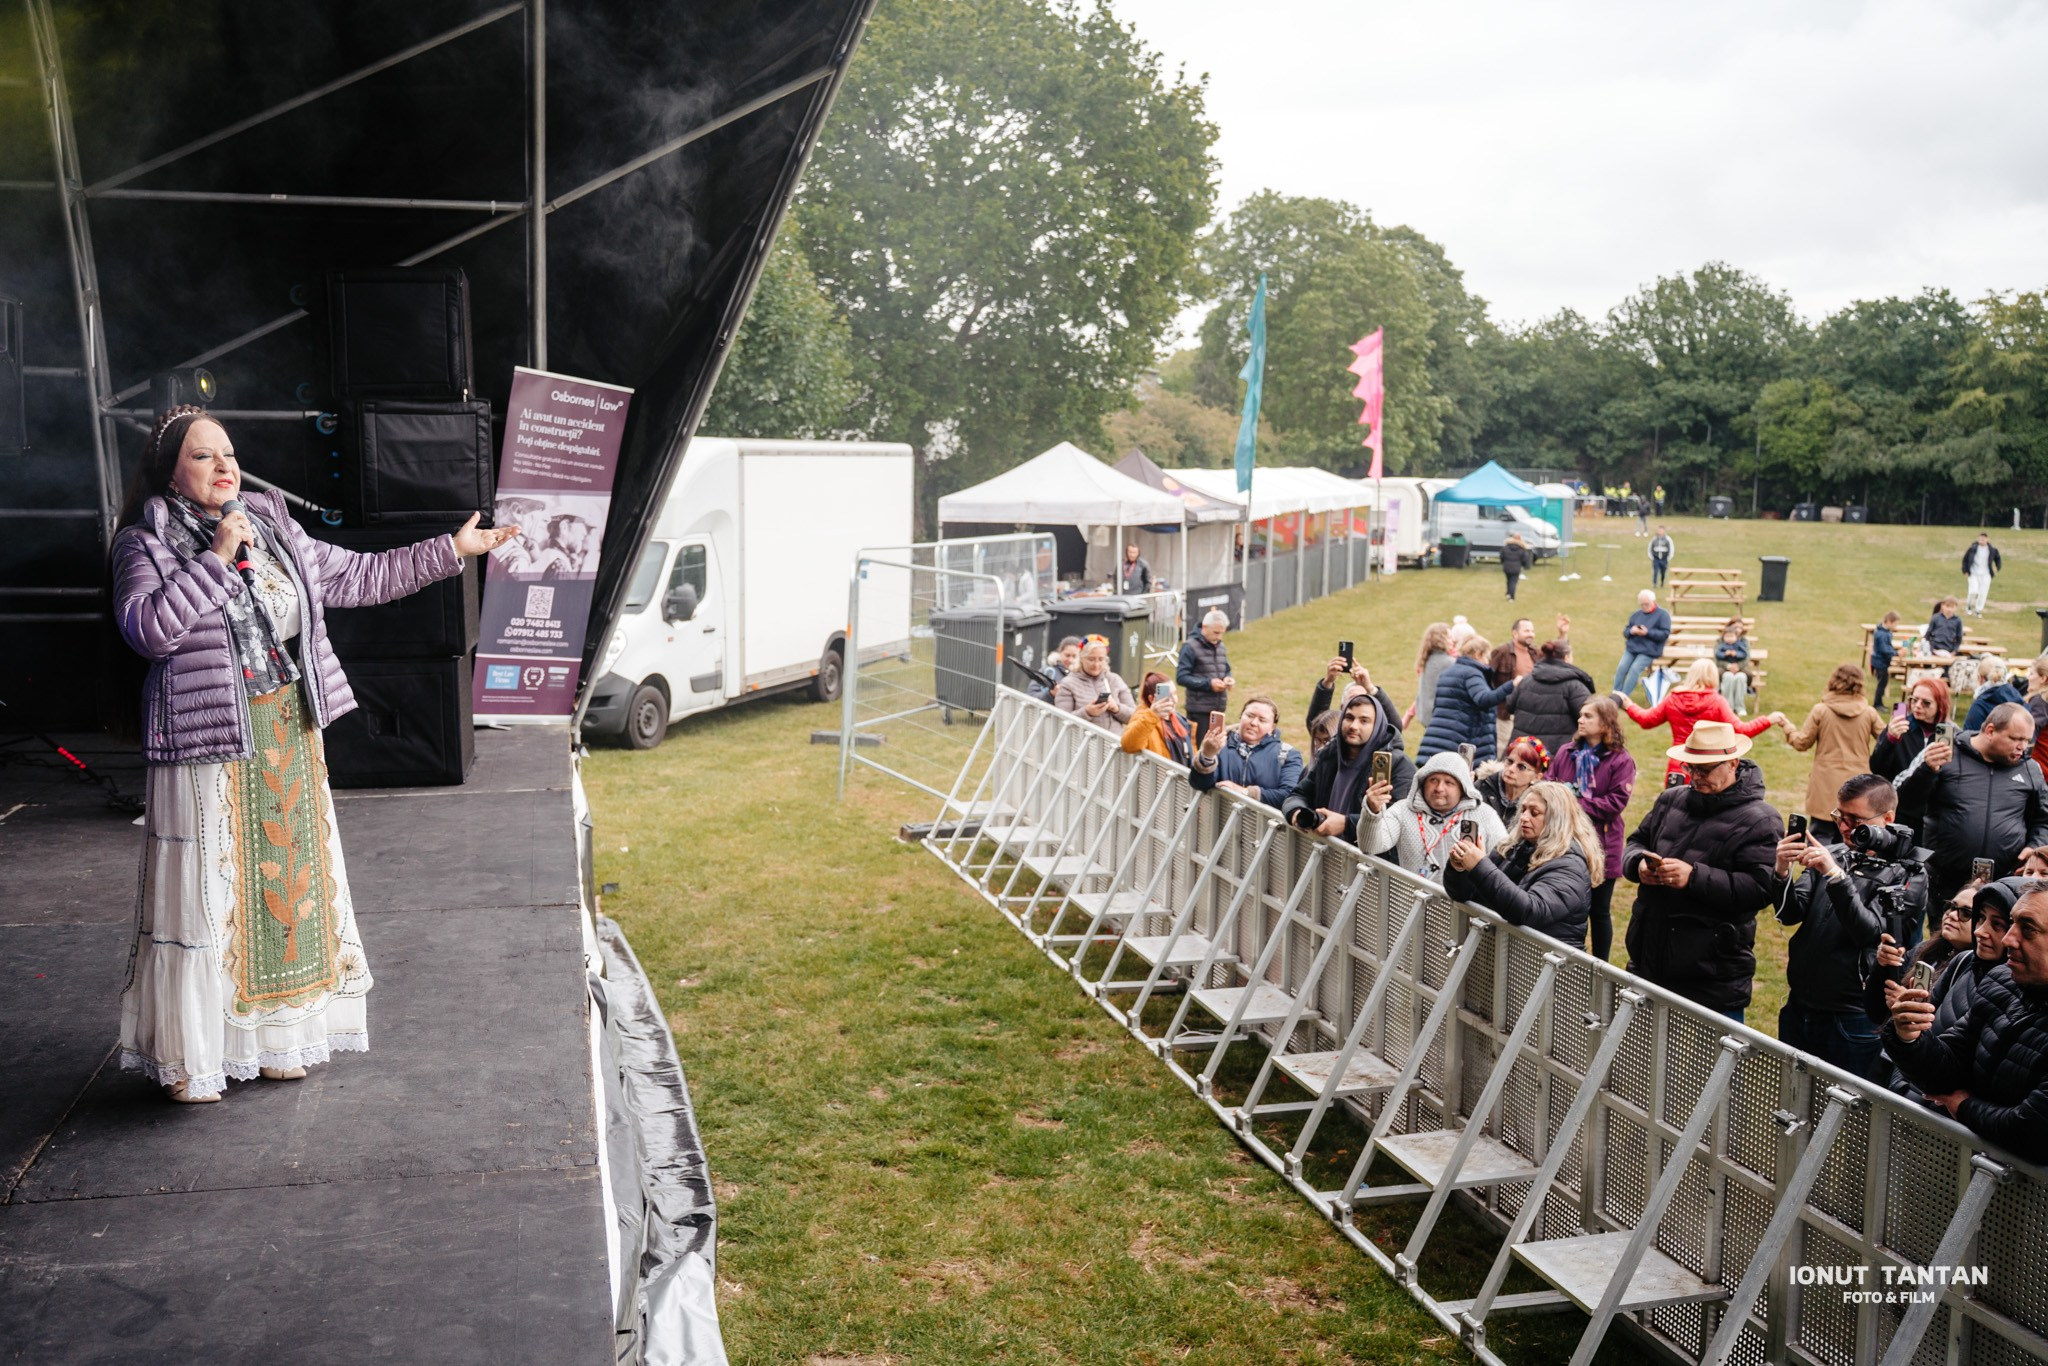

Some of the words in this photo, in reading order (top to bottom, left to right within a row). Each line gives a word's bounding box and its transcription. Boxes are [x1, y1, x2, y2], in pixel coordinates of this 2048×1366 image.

[551, 390, 595, 408] Osbornes
[520, 408, 532, 419] Ai
[533, 412, 553, 423] avut
[554, 416, 567, 425] un
[567, 418, 605, 432] accident
[511, 618, 525, 627] 020
[526, 618, 544, 628] 7482
[550, 631, 563, 639] 733
